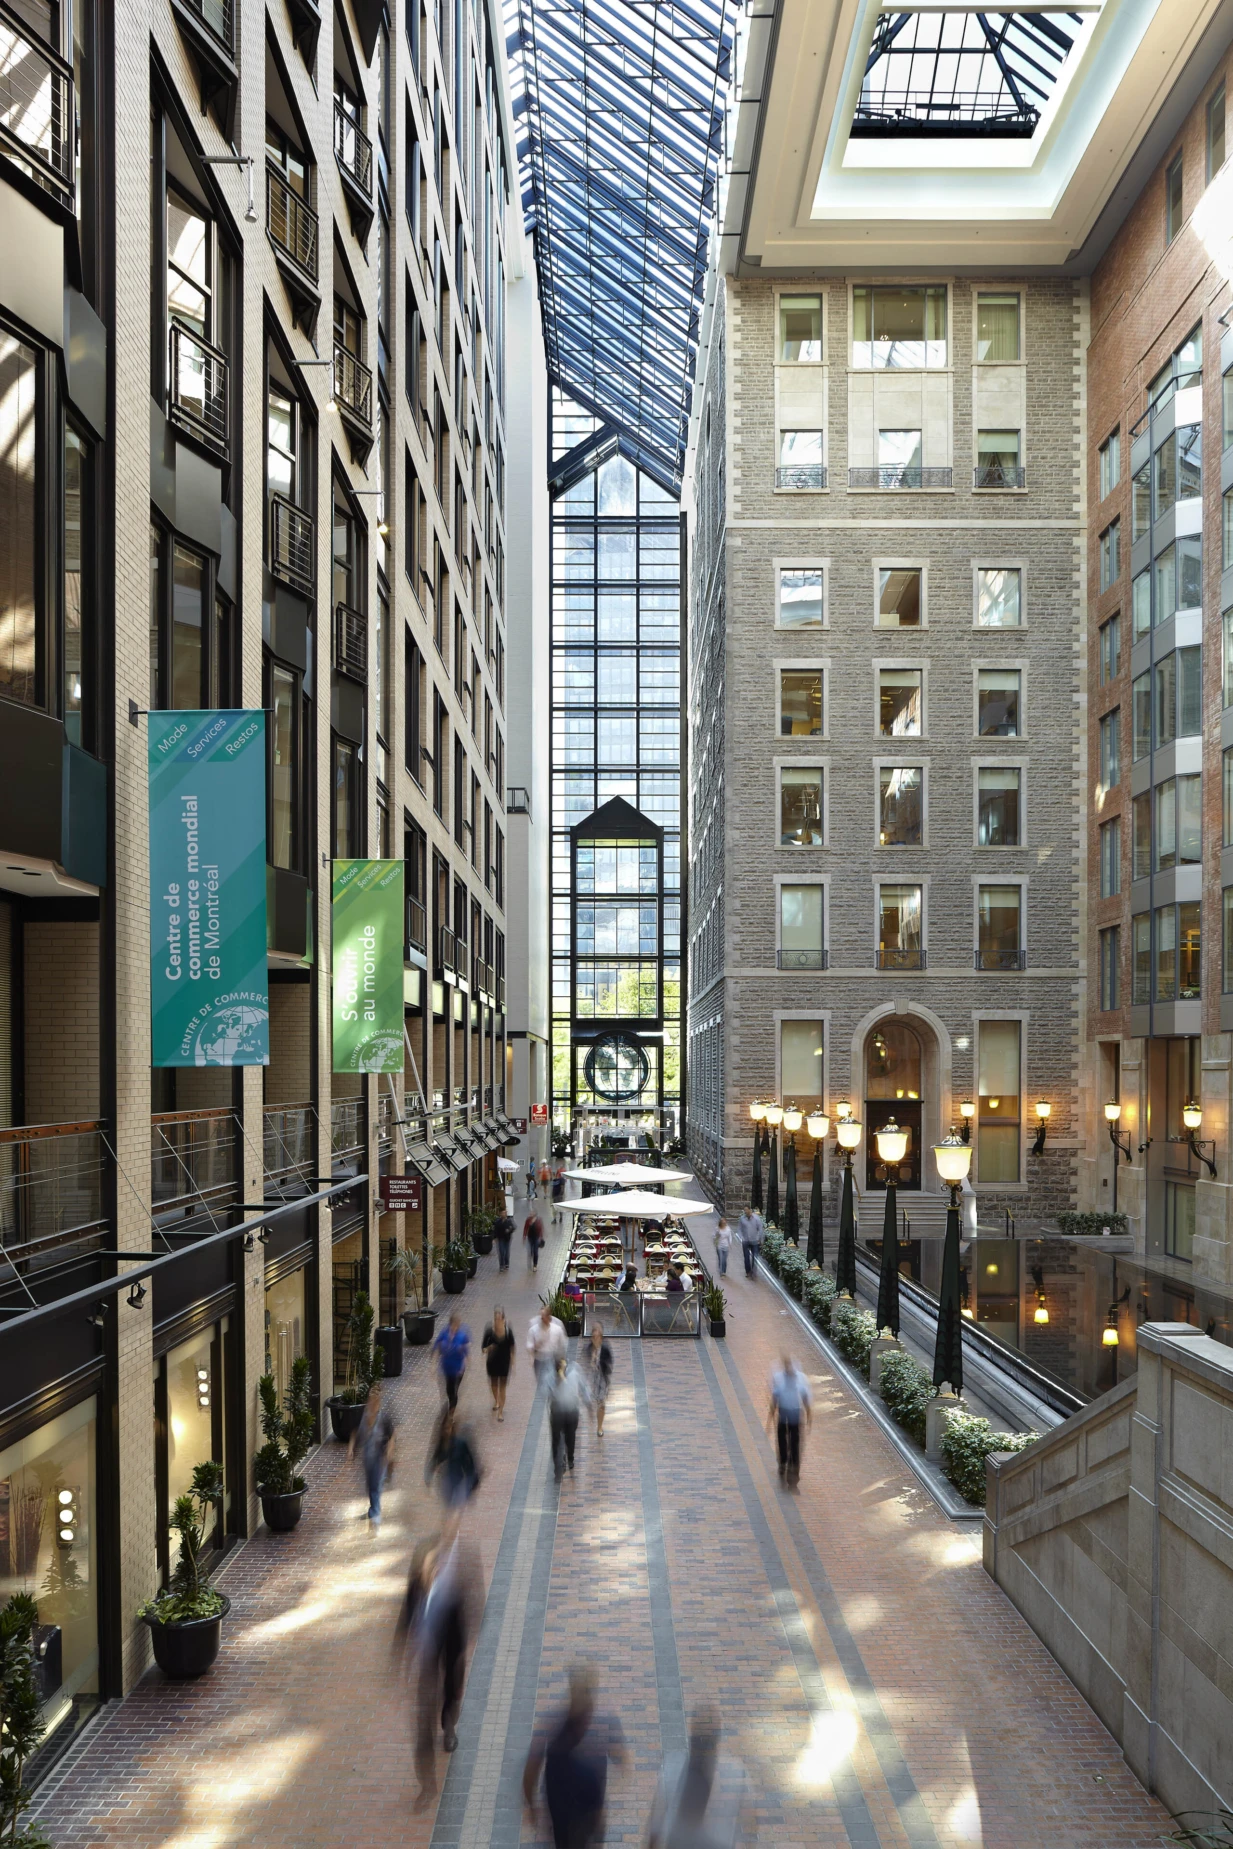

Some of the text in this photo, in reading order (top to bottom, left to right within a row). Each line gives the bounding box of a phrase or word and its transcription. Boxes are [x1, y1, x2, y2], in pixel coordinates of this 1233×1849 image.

[158, 723, 188, 753] Mode
[187, 718, 227, 758] Services
[225, 722, 259, 755] Restos
[181, 795, 201, 980] commerce mondial
[340, 866, 359, 885] Mode
[357, 864, 382, 888] Services
[380, 867, 401, 887] Restos
[163, 882, 182, 981] Centre de
[202, 864, 221, 980] de Montréal
[341, 947, 358, 1021] S'ouvrir
[358, 925, 376, 1021] au monde
[181, 1016, 200, 1056] CENTRE
[199, 1003, 213, 1016] DE
[350, 1043, 362, 1067] CENTRE
[361, 1035, 370, 1044] DE
